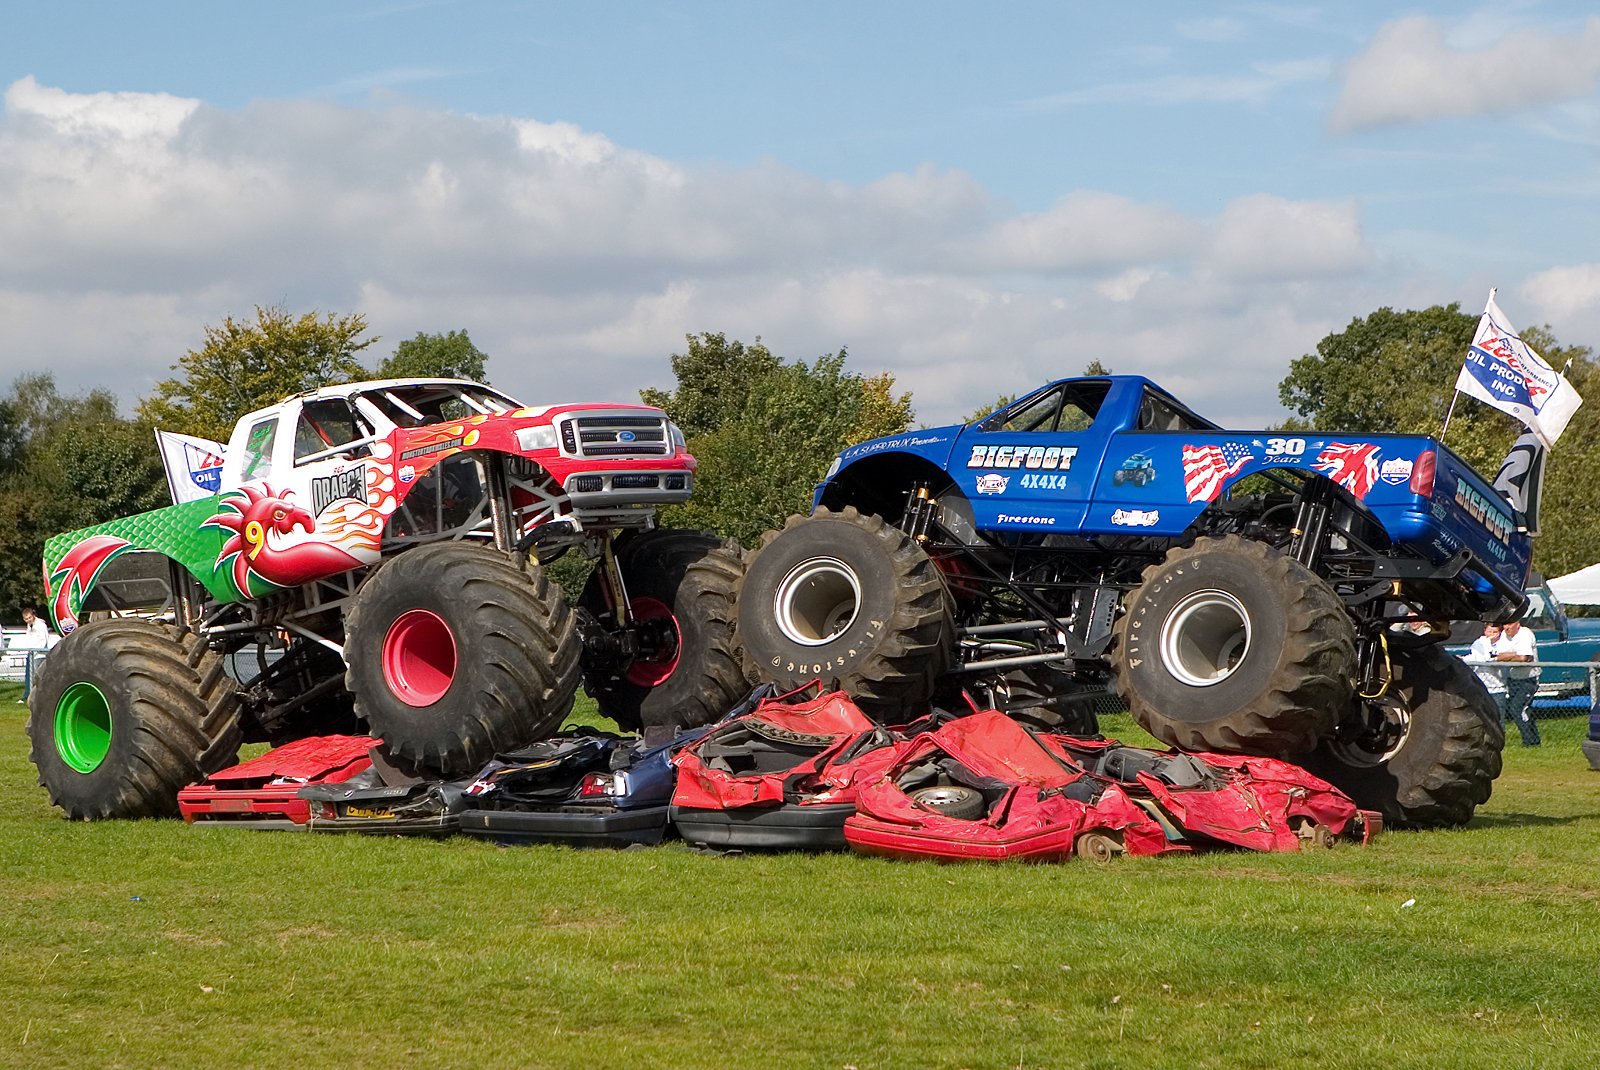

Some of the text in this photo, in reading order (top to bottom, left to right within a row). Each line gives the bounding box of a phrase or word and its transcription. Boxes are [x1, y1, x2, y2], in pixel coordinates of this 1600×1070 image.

[1466, 350, 1486, 367] OIL
[1491, 379, 1517, 398] INC.
[1264, 438, 1306, 455] 30
[966, 445, 1080, 471] BIGFOOT
[1262, 455, 1302, 465] Years
[195, 473, 216, 483] OIL
[1020, 474, 1067, 490] 4X4X4
[312, 464, 368, 517] DRAGON
[997, 513, 1056, 525] Firestone
[1455, 477, 1514, 547] BIGFOOT
[246, 520, 264, 561] 9
[1486, 539, 1507, 562] 4X4X4
